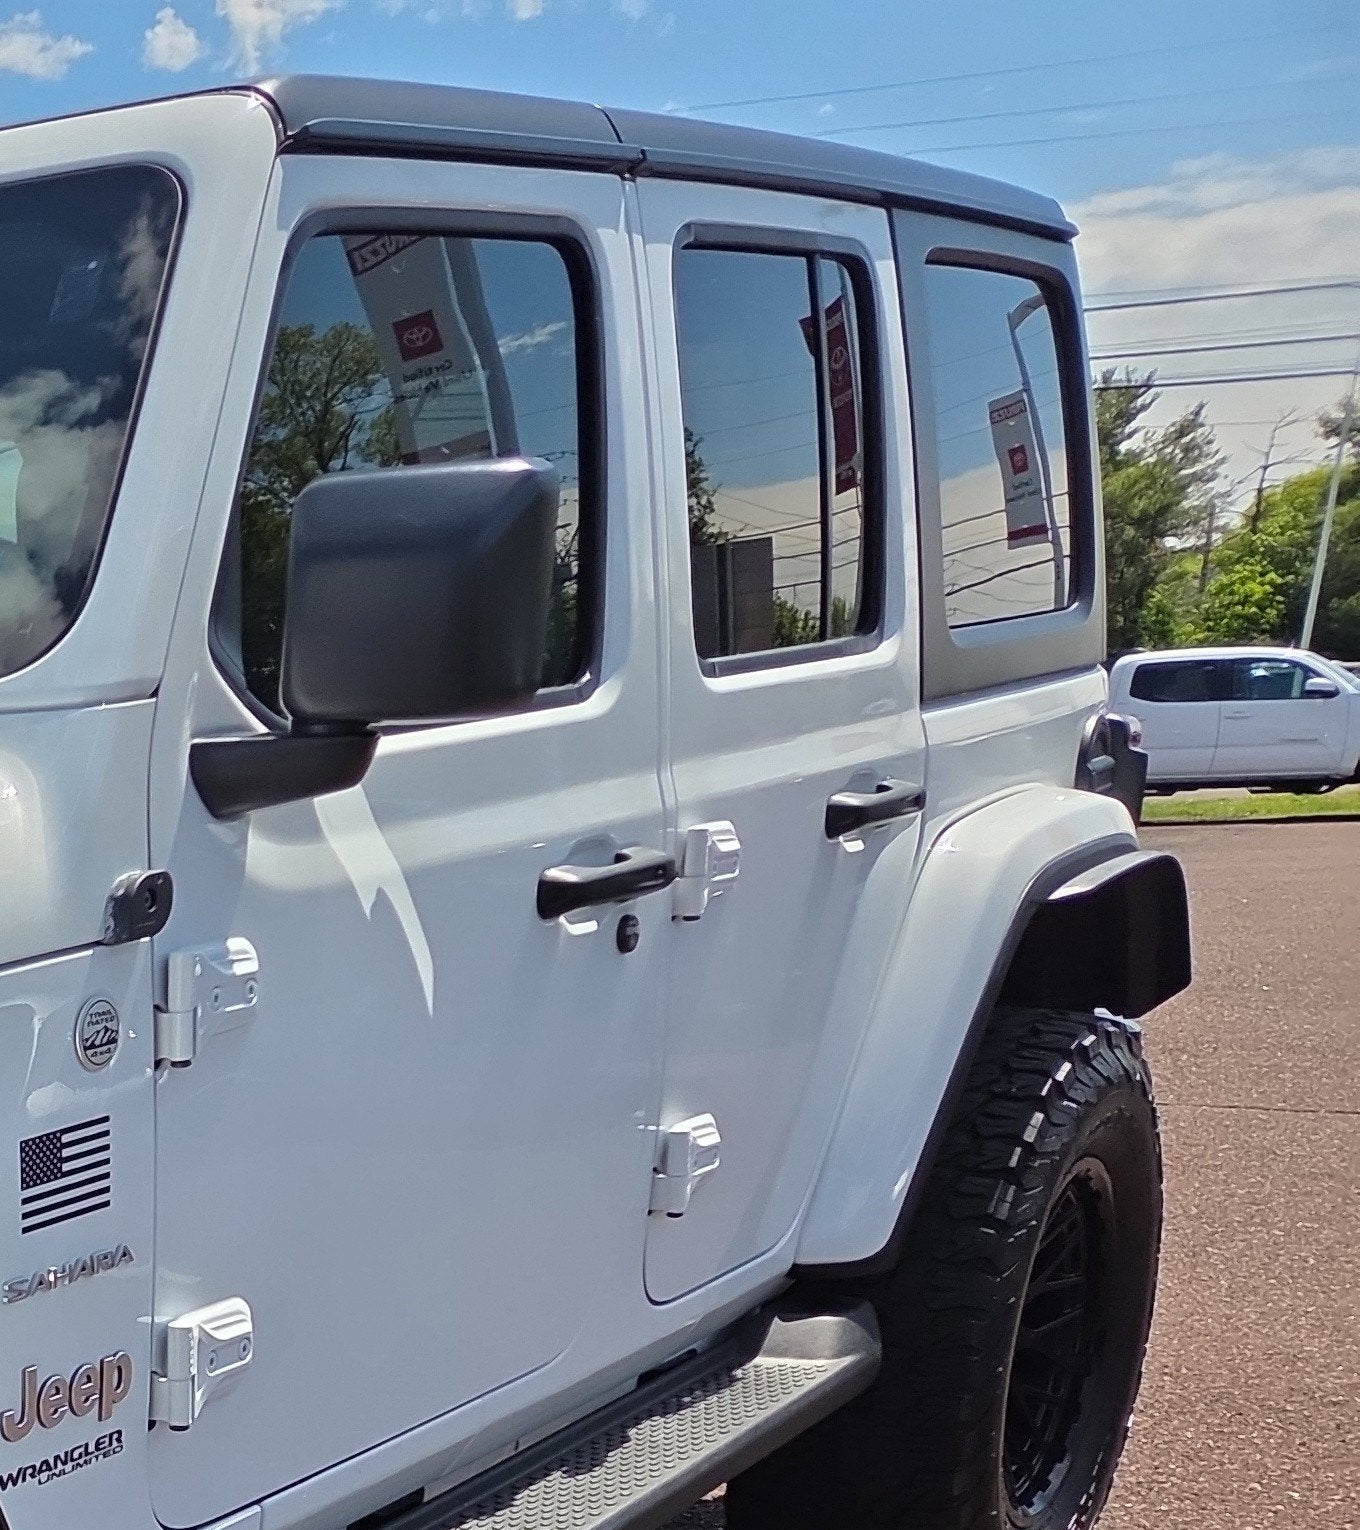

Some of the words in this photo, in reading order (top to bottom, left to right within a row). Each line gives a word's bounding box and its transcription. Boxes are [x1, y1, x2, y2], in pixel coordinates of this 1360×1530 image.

[86, 1015, 115, 1028] RATED
[2, 1242, 135, 1305] SAHARA
[37, 1444, 124, 1486] UNLIMITED
